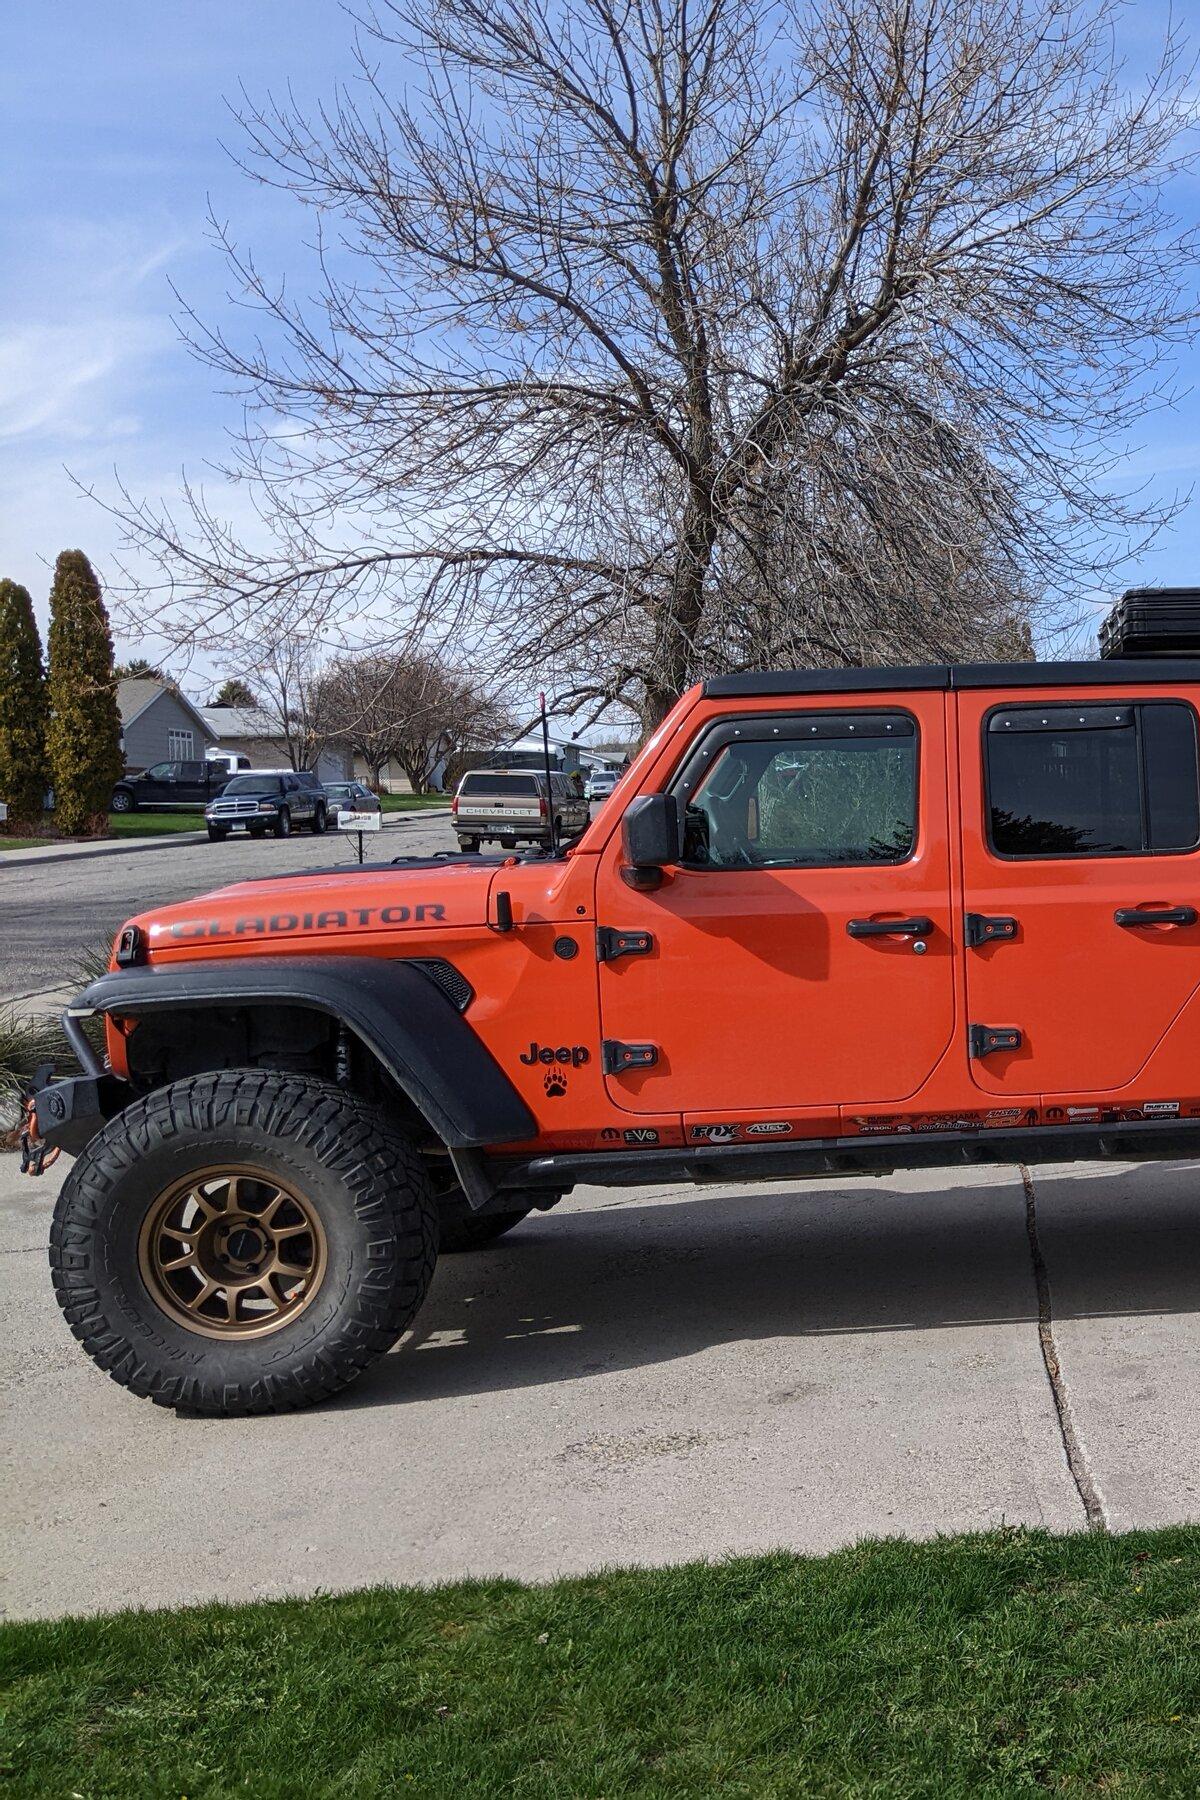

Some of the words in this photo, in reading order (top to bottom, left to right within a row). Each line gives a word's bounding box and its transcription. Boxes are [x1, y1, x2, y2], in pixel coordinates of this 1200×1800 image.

[171, 904, 447, 938] GLADIATOR
[520, 1043, 589, 1068] Jeep
[692, 1124, 740, 1138] FOX
